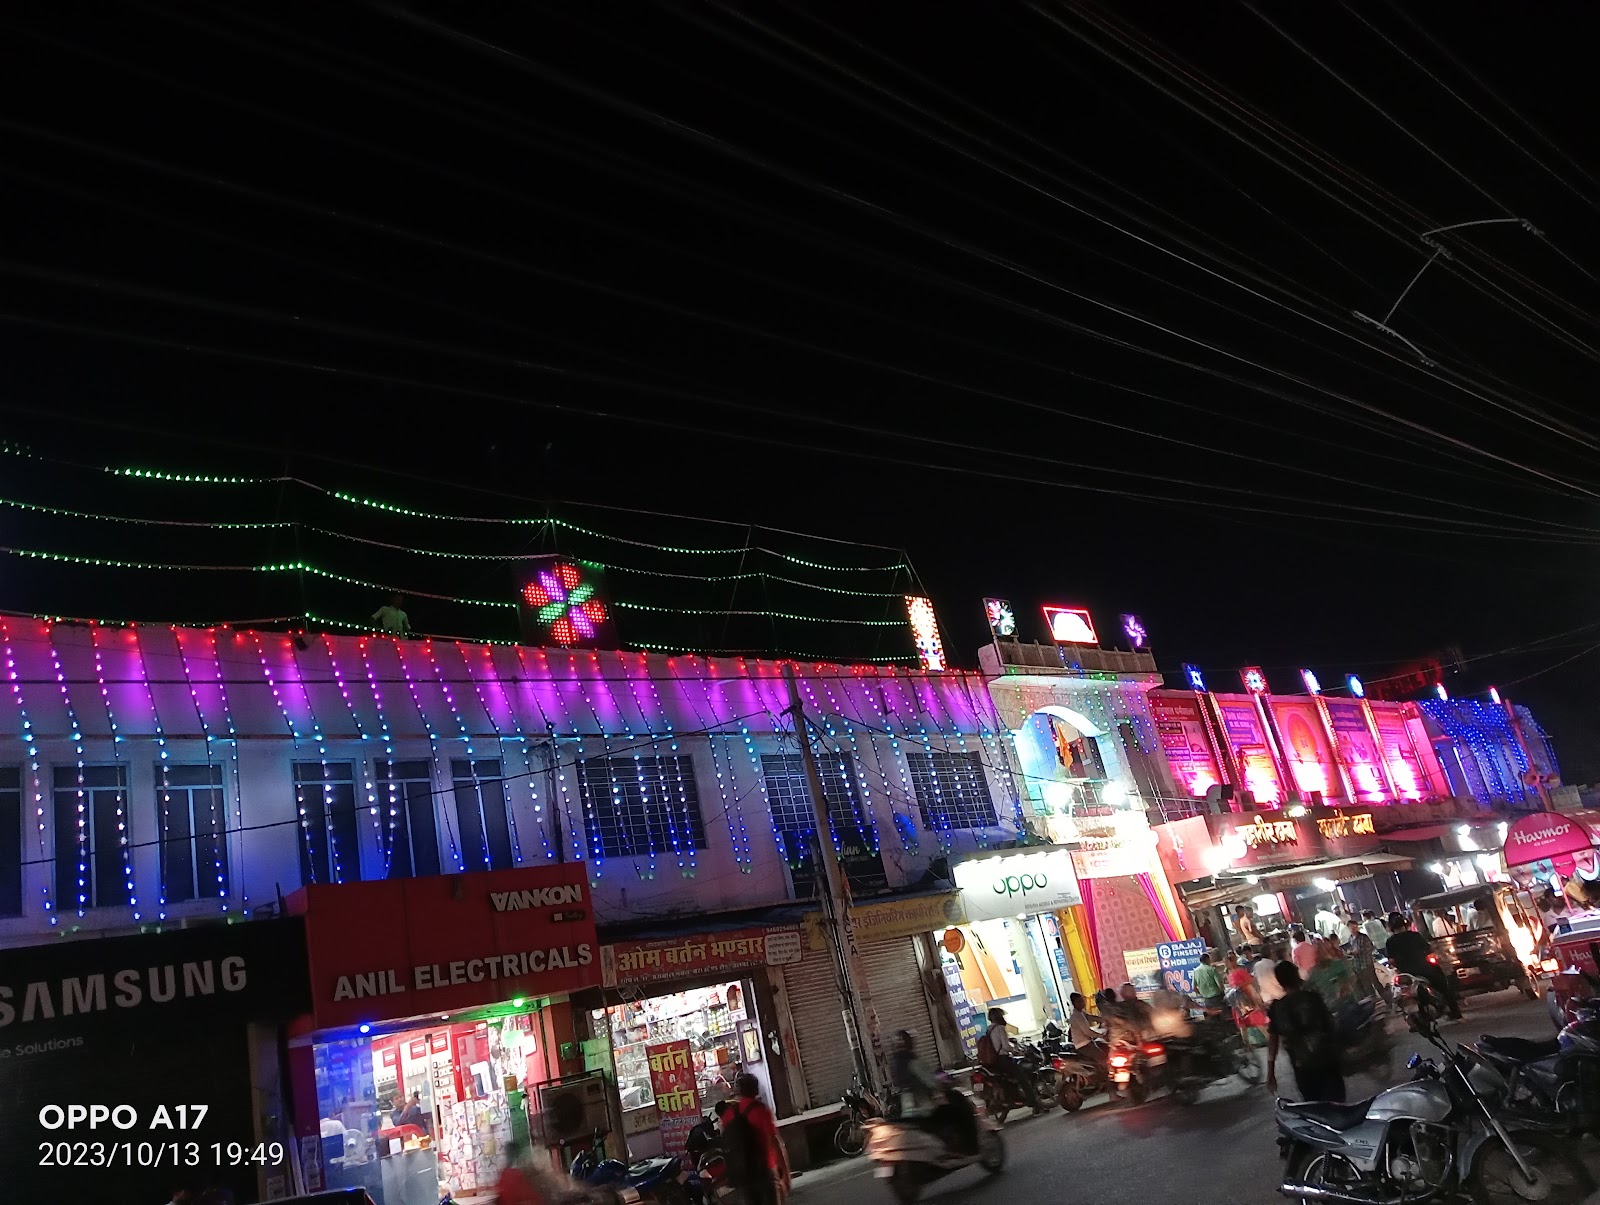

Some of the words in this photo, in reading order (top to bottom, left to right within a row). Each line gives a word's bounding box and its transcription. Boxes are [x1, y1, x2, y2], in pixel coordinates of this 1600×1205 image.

[1513, 823, 1571, 846] Havmor
[617, 945, 661, 972] ओम
[665, 940, 707, 965] बर्तन
[711, 936, 765, 958] भण्डार
[1171, 941, 1202, 950] BAJAJ
[1172, 948, 1204, 958] FINSERV
[1569, 948, 1593, 962] Hav
[333, 970, 405, 1003] ANIL
[414, 943, 593, 991] ELECTRICALS
[1170, 958, 1187, 967] HDB
[0, 955, 248, 1029] SAMSUNG
[15, 1036, 85, 1057] Solutions
[649, 1045, 689, 1074] बर्तन
[655, 1085, 696, 1113] बर्तन
